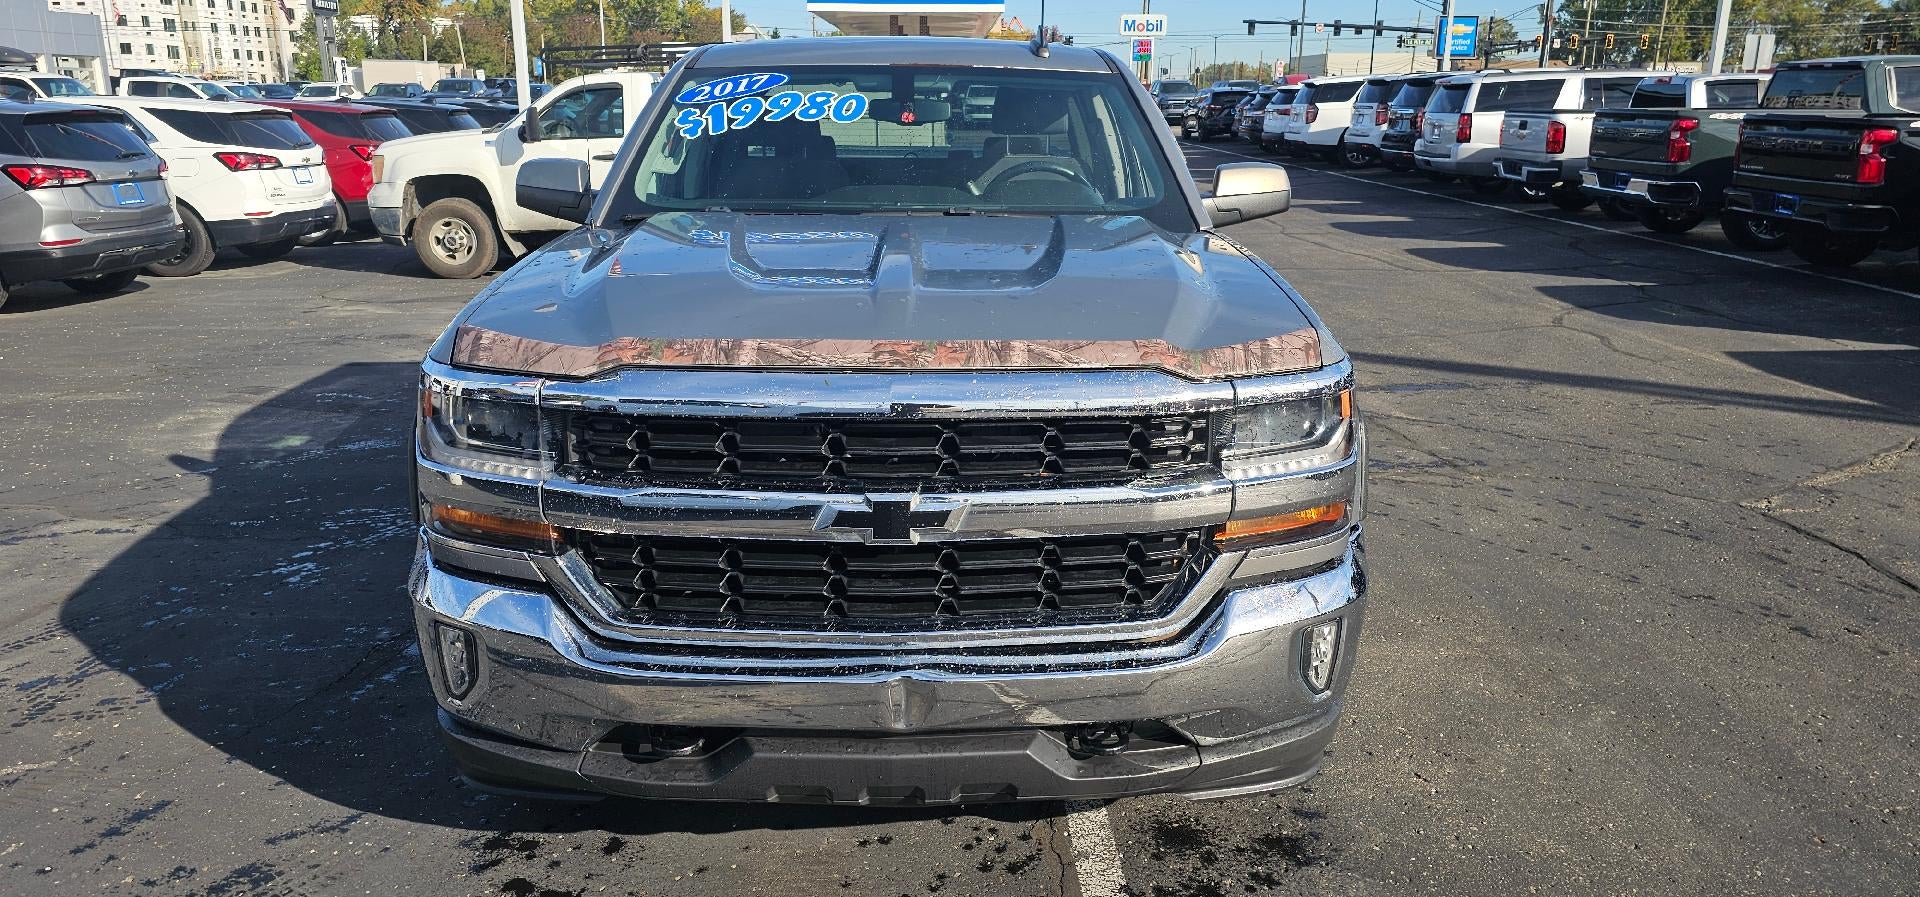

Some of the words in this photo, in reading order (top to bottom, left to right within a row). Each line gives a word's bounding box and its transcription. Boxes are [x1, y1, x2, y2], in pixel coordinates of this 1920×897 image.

[1123, 19, 1163, 32] Mobil
[692, 75, 771, 102] 2017
[674, 91, 868, 139] $19980
